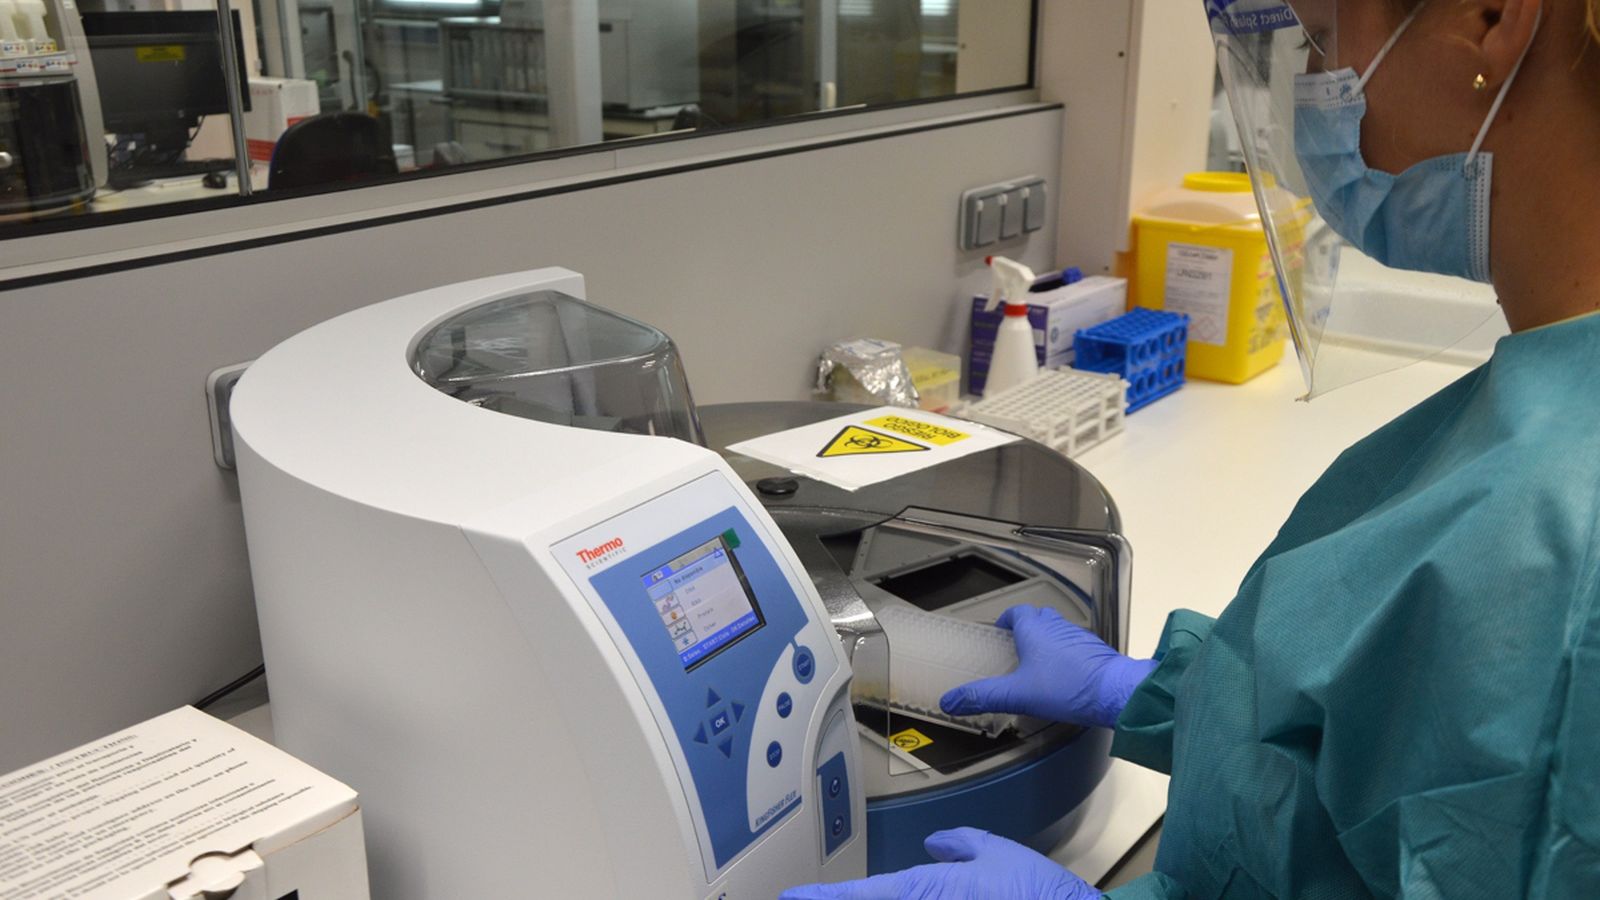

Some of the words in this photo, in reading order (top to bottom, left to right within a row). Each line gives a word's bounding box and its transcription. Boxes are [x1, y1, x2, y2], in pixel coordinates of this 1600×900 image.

[883, 423, 937, 440] RIESGO
[576, 537, 623, 563] Thermo
[586, 547, 627, 569] SCIENTIFIC
[715, 716, 726, 728] OK
